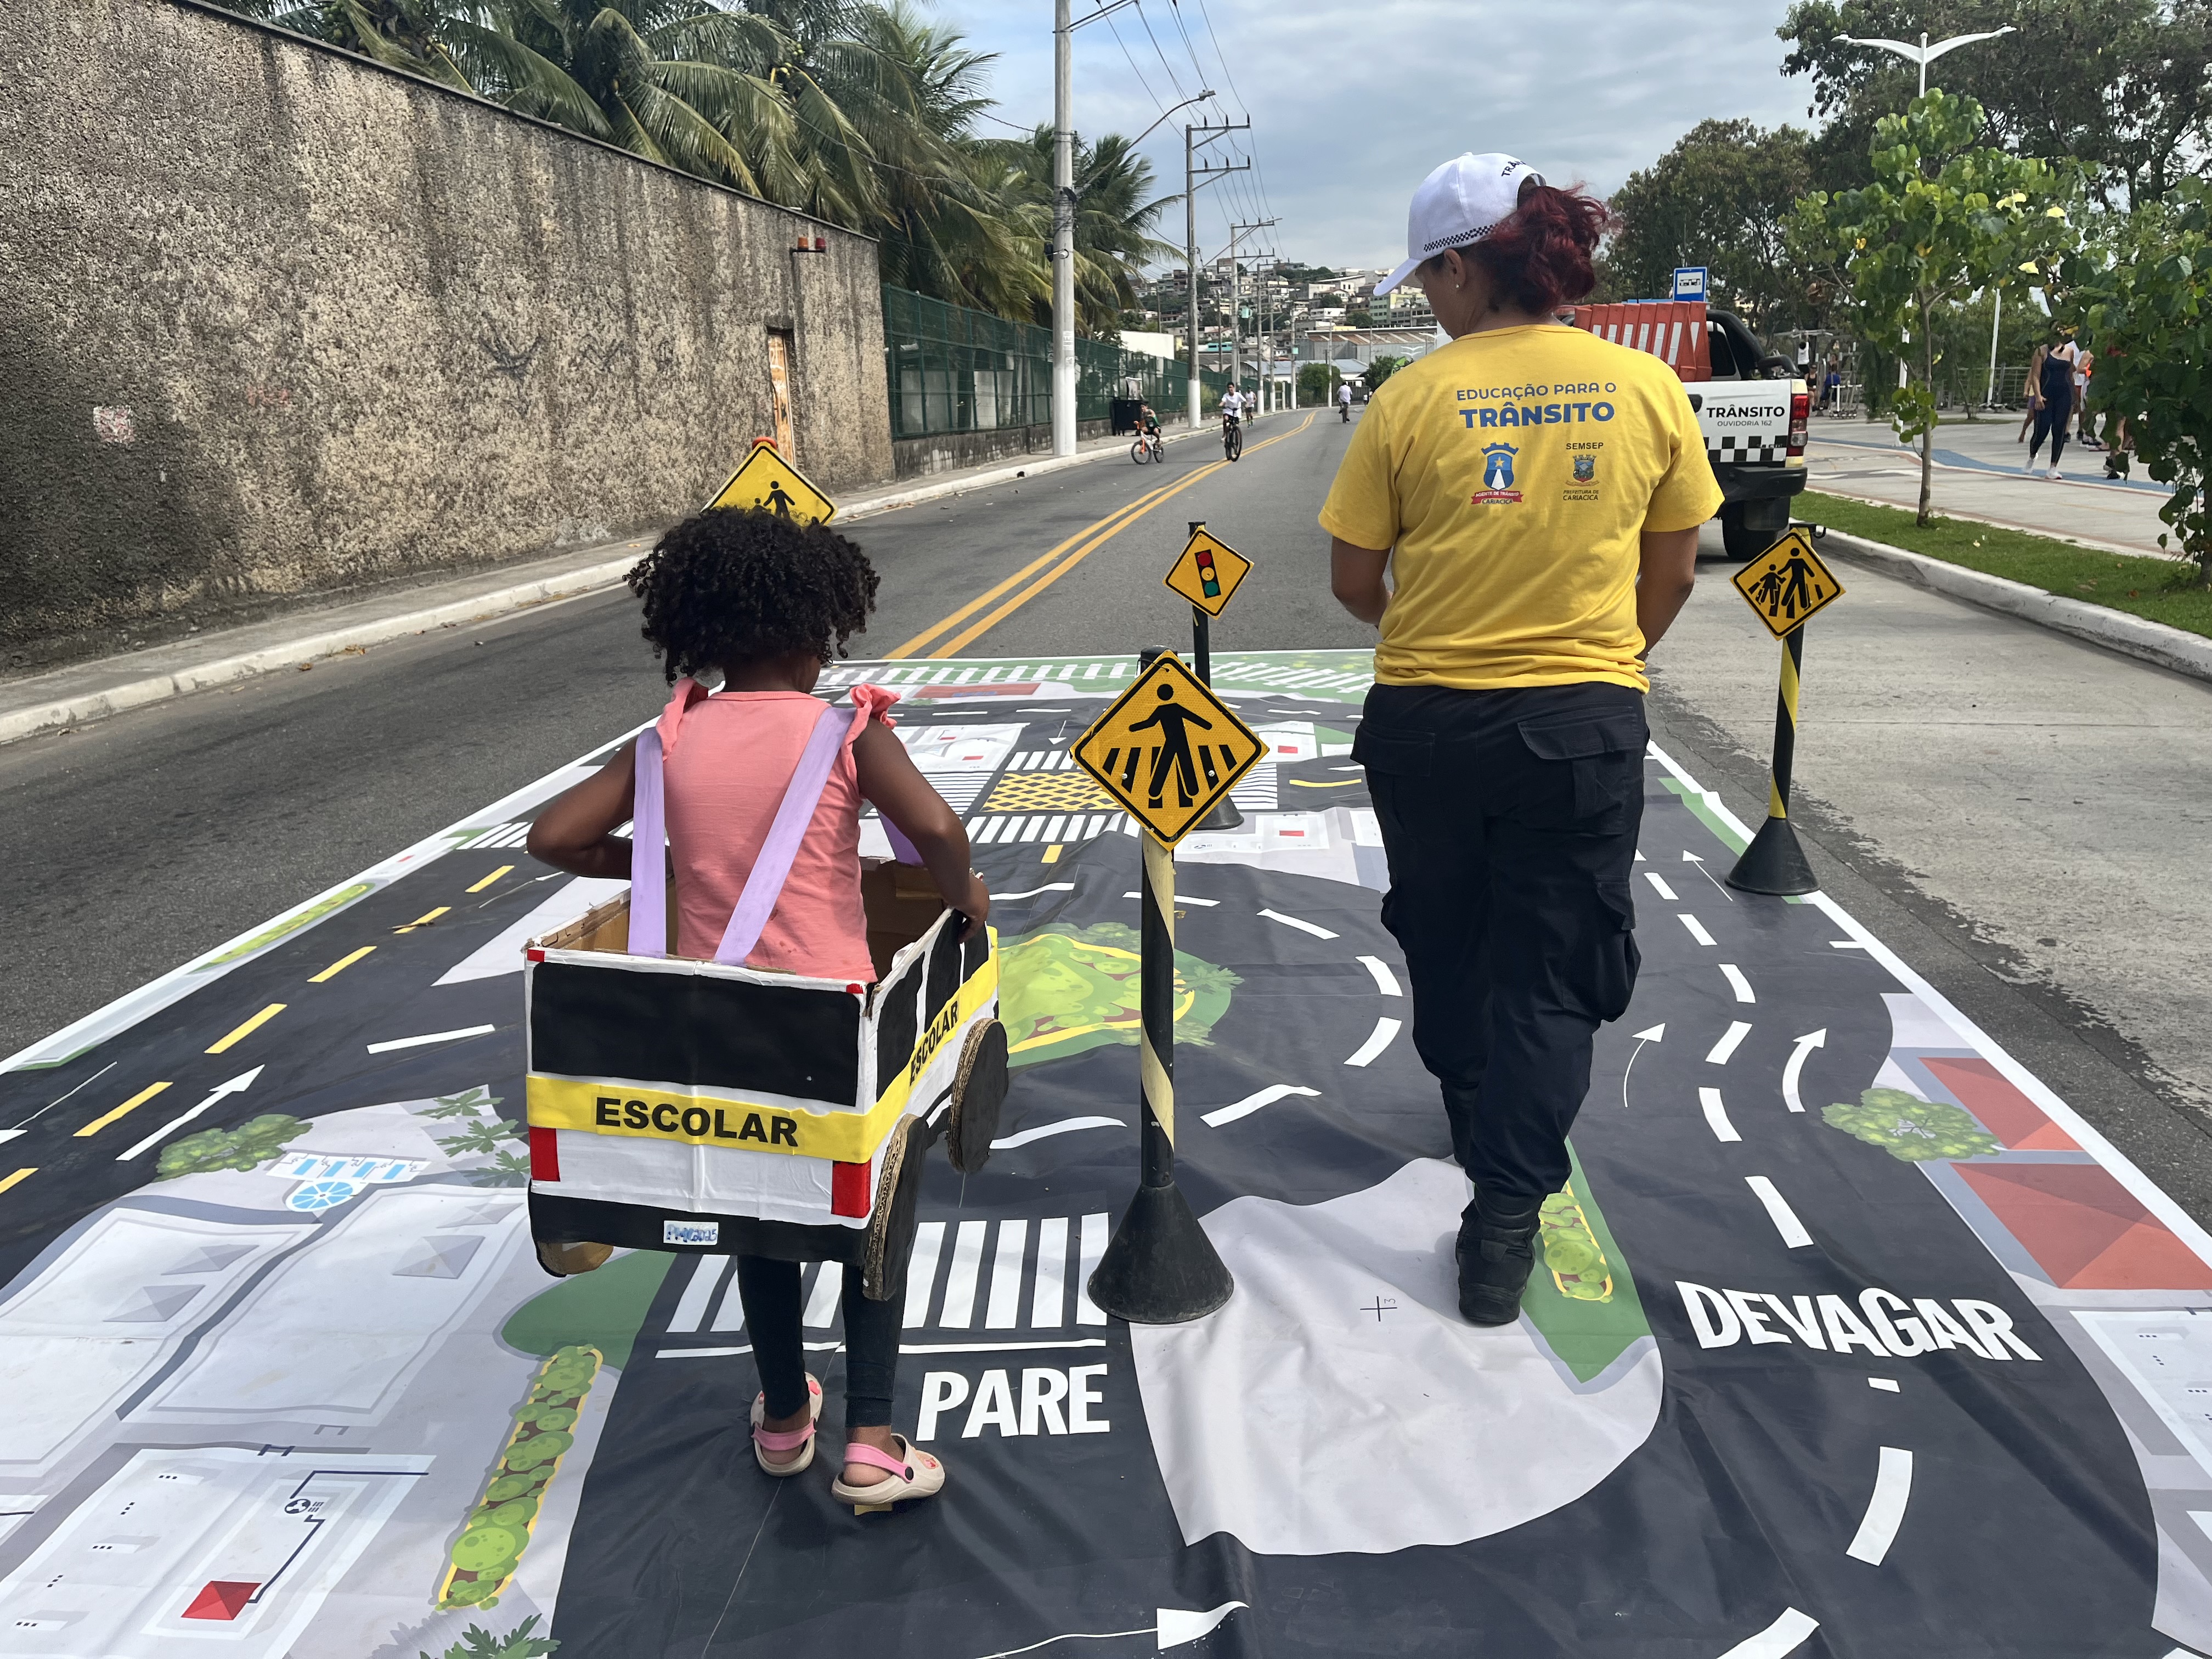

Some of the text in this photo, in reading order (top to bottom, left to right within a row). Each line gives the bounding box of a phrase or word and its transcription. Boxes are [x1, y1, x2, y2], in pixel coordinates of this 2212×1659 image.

[1457, 382, 1617, 400] EDUCAÇÃO PARA O
[1459, 402, 1615, 428] TRÂNSITO
[1706, 404, 1785, 418] TRÂNSITO
[910, 1001, 958, 1087] ESCOLAR
[595, 1097, 798, 1147] ESCOLAR
[1674, 1280, 2043, 1362] DEVAGAR
[916, 1363, 1110, 1442] PARE
